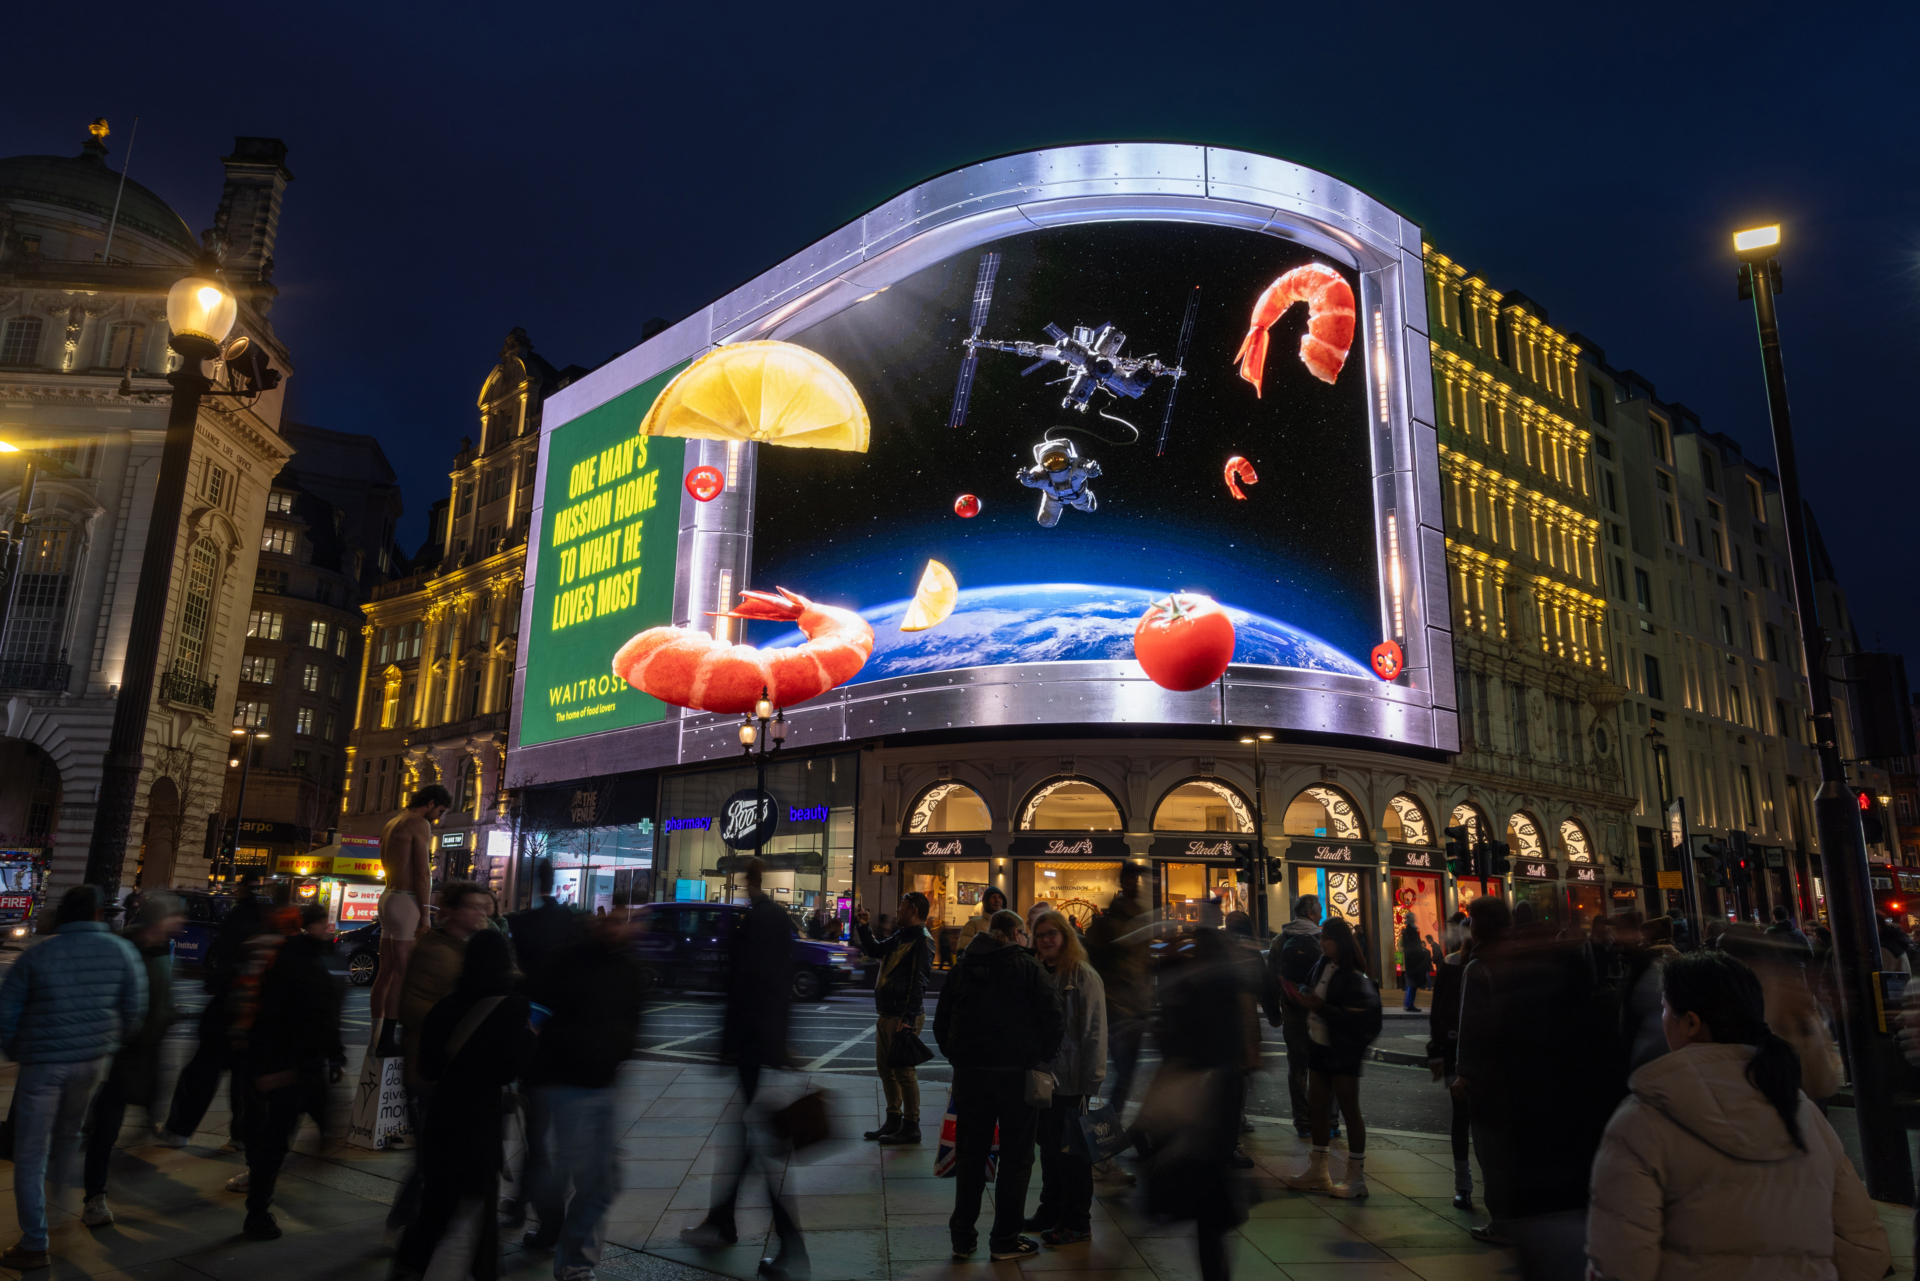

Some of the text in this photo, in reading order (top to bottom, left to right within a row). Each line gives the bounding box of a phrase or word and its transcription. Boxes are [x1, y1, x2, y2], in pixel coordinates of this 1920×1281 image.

[196, 423, 252, 472] ALLIANCE LIFE OFFICE
[569, 434, 649, 500] ONE MAN'S
[552, 469, 659, 547] MISSION HOME
[559, 520, 643, 586] TO WHAT HE
[552, 566, 642, 631] LOVES MOST
[549, 674, 628, 706] WAITROSE
[556, 702, 616, 722] The home of food lovers
[582, 790, 598, 806] THE
[571, 806, 598, 823] VENUE
[789, 804, 829, 823] beauty
[665, 816, 712, 833] pharmacy
[922, 840, 954, 855] Lindt
[1044, 839, 1083, 854] Lindt
[1185, 841, 1222, 856] Lindt
[1314, 846, 1344, 860] Lindt
[279, 860, 294, 868] HOT
[295, 860, 310, 868] DOG
[311, 861, 330, 869] SPOT
[1405, 852, 1425, 866] Lindt
[872, 864, 886, 873] Lindt
[1612, 890, 1630, 898] Lindt
[0, 897, 27, 908] FIRE
[177, 941, 199, 950] Institute
[385, 1072, 400, 1086] do
[381, 1088, 407, 1104] give
[382, 1121, 402, 1137] just
